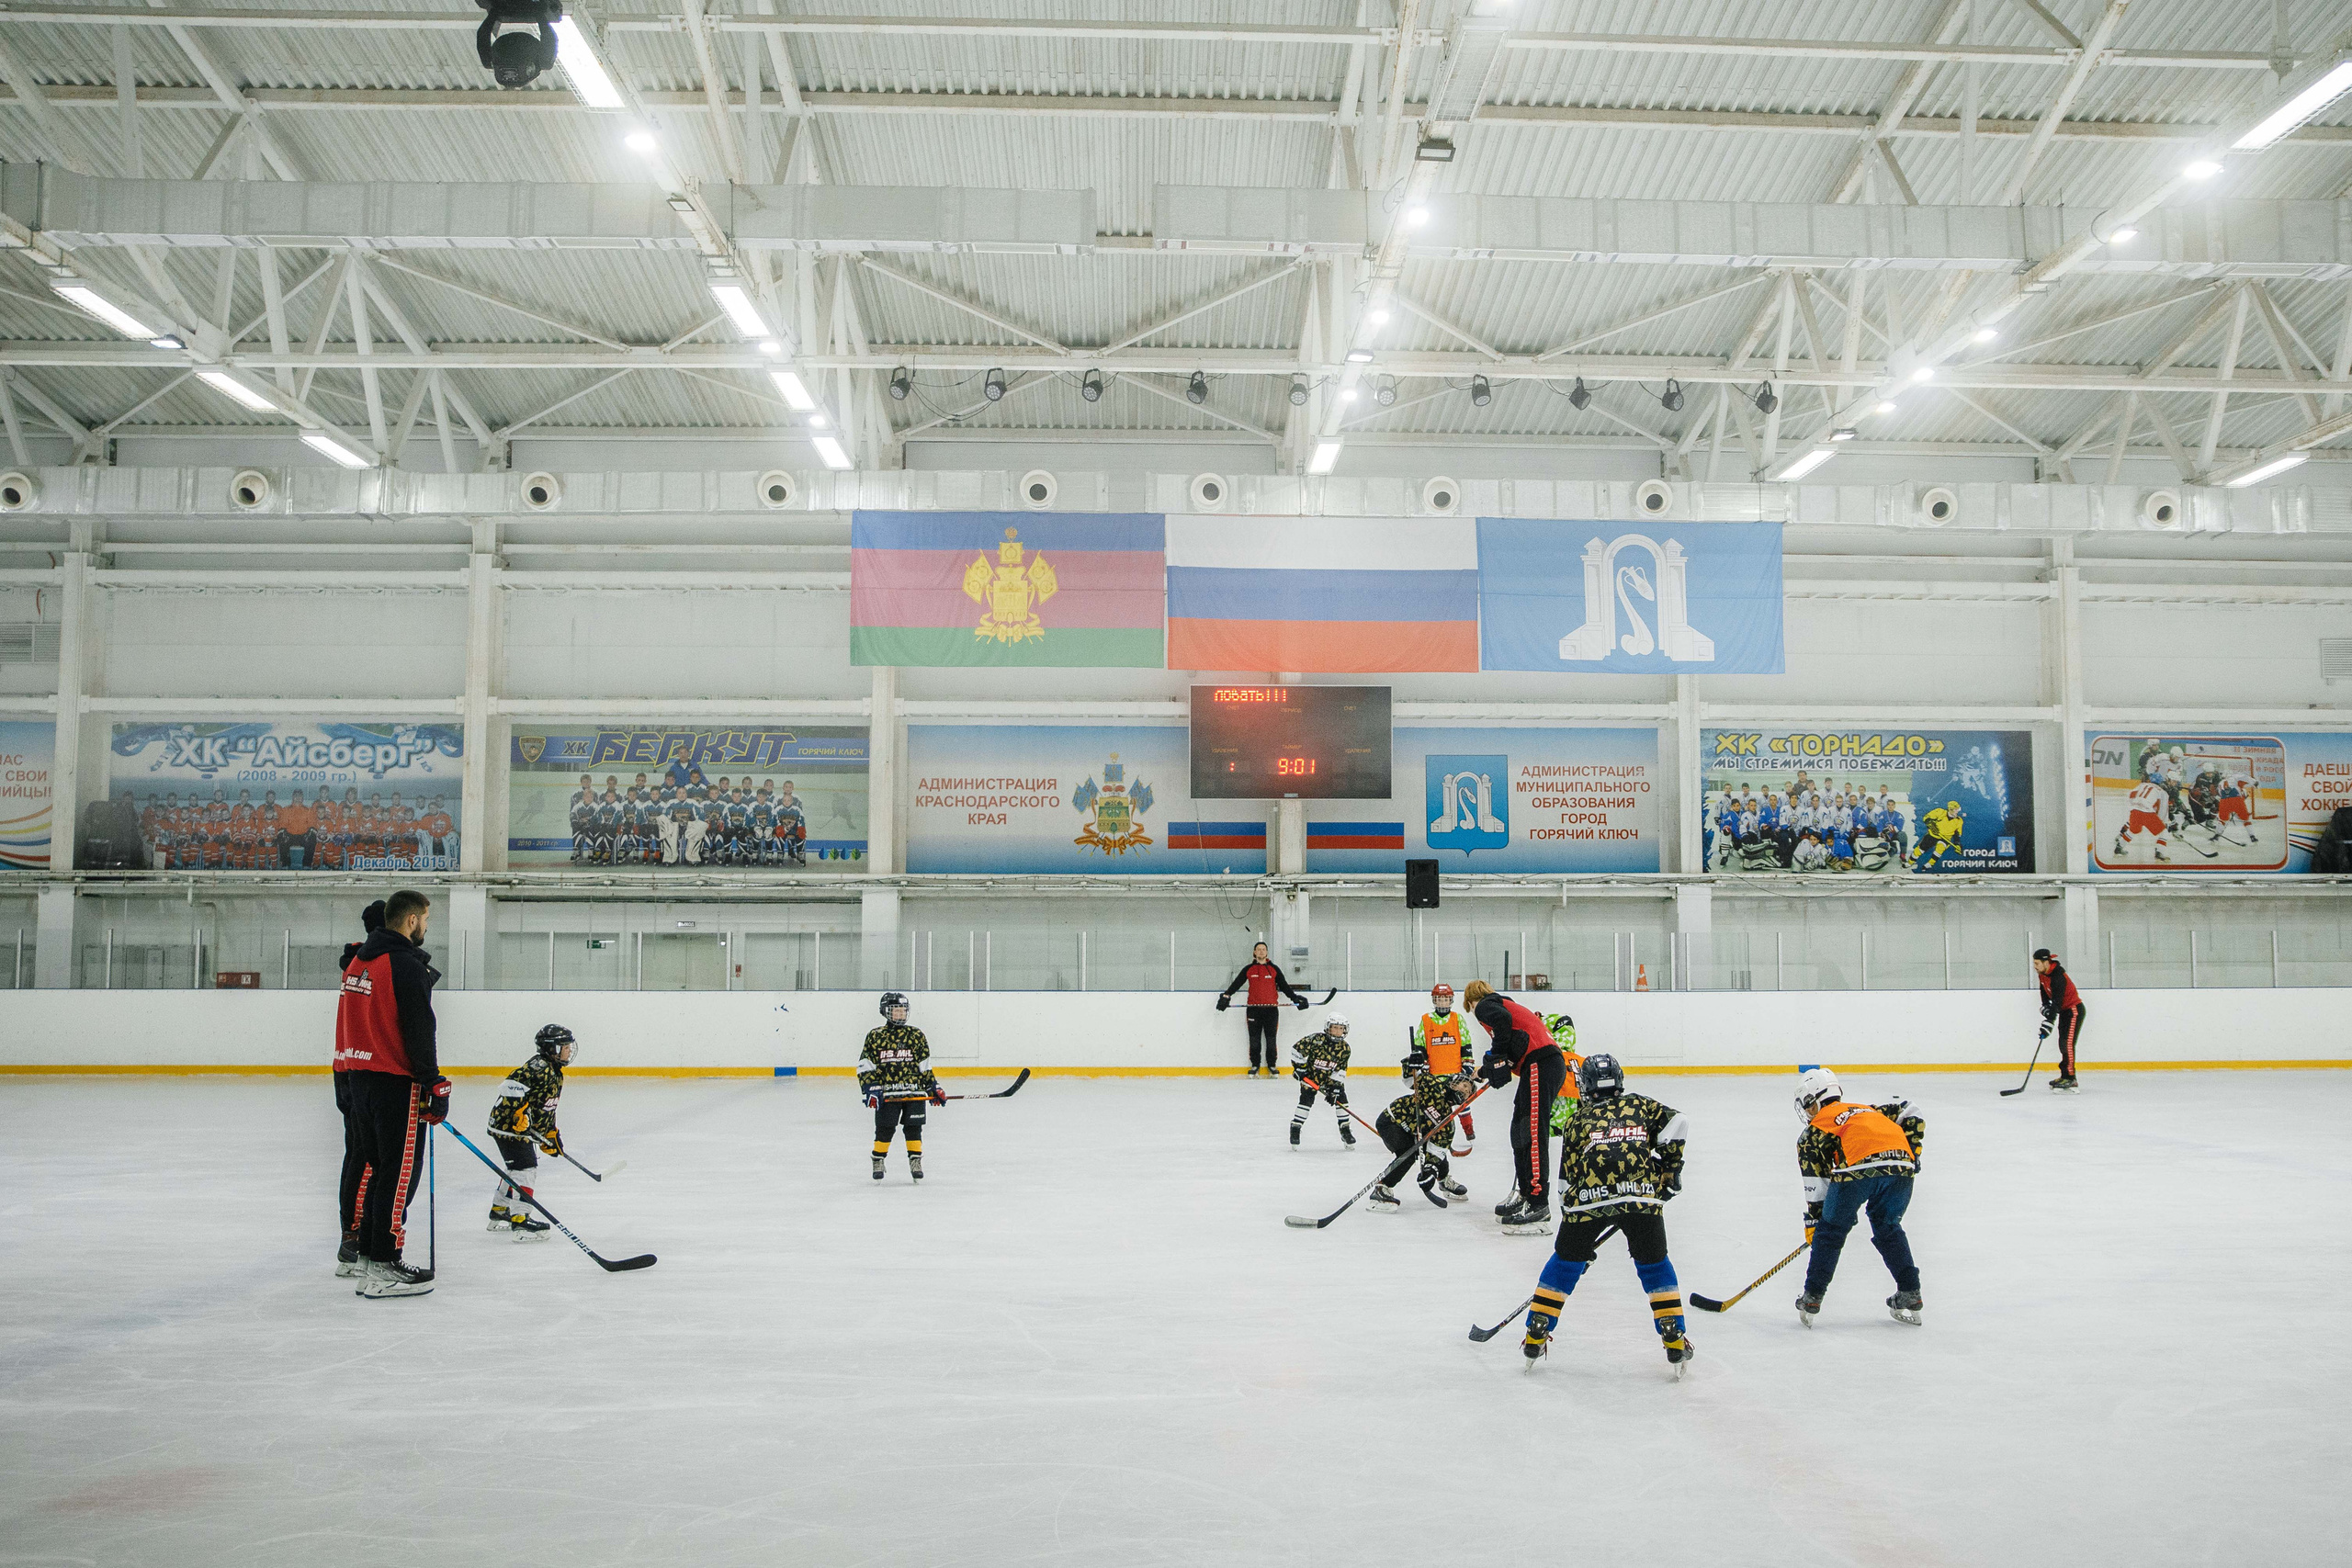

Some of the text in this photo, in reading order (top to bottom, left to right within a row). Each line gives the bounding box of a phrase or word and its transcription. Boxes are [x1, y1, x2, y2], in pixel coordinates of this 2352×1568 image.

[171, 736, 228, 767] ХК
[561, 740, 590, 755] ХК
[588, 730, 797, 768] БЕРКУТ
[797, 747, 865, 756] ГОРЯЧИЙ КЛЮЧ
[1715, 733, 1945, 756] ХК «ТОРНАДО»
[0, 754, 23, 766] АС
[1278, 758, 1316, 775] 9:01
[1713, 757, 1947, 771] МЫ СТРЕМИМСЯ ПОБЕЖДАТЬ!!!
[6, 770, 48, 782] СВОИ
[236, 770, 277, 782] (2008
[292, 771, 327, 781] 2009
[1521, 765, 1645, 779] АДМИНИСТРАЦИЯ
[2303, 763, 2352, 777] ДАЕШ
[0, 784, 51, 799] ИЙЦЫ!
[918, 778, 1057, 792] АДМИНИСТРАЦИЯ
[1516, 781, 1651, 794] МУНИЦИПАЛЬНОГО
[915, 795, 1060, 809] КРАСНОДАРСКОГО
[1532, 796, 1635, 809] ОБРАЗОВАНИЯ
[2301, 798, 2352, 811] ХОККЕ
[967, 813, 1008, 825] КРАЯ
[1561, 812, 1607, 826] ГОРОД
[1530, 826, 1639, 840] ГОРЯЧИЙ КЛЮЧ
[1962, 849, 1996, 857] ГОРОД
[353, 855, 413, 871] Декабрь
[413, 855, 447, 869] 2015
[1941, 859, 2018, 868] ГОРЯЧИЙ КЛЮЧ
[1609, 1125, 1647, 1137] MHL
